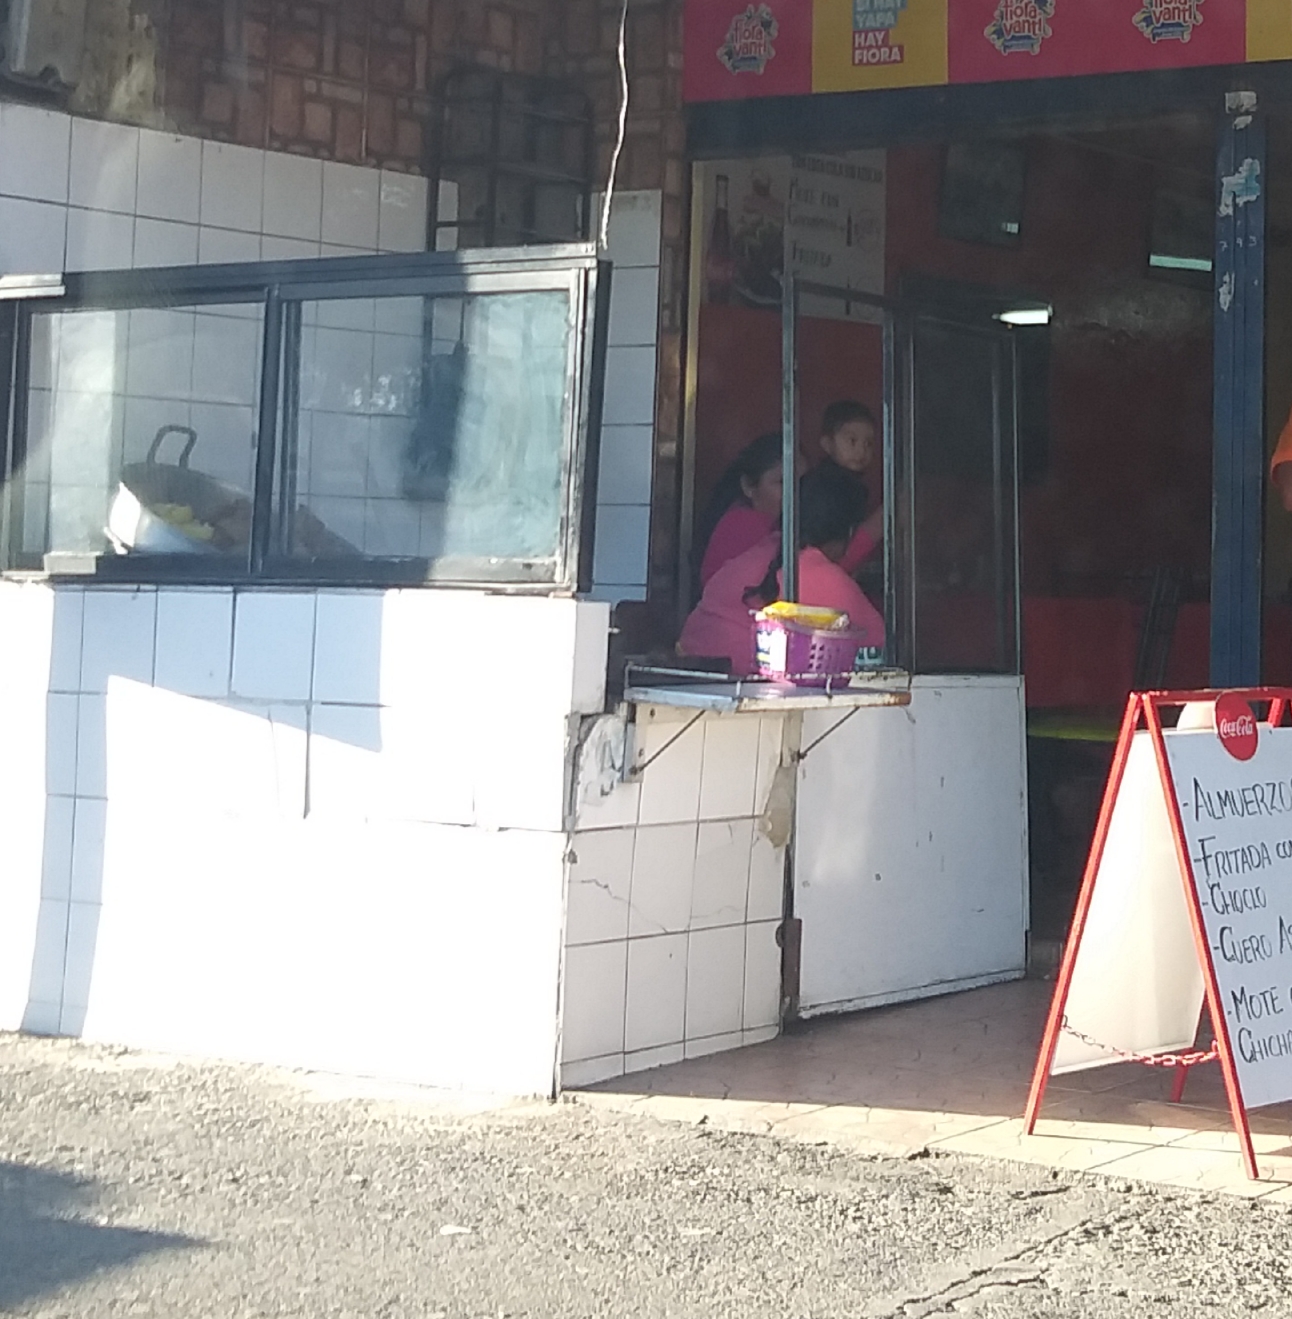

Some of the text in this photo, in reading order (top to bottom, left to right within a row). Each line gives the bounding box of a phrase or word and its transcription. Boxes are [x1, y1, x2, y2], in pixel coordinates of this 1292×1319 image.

[855, 11, 896, 28] YAPA
[854, 31, 885, 48] HAY
[854, 47, 901, 64] FIORA
